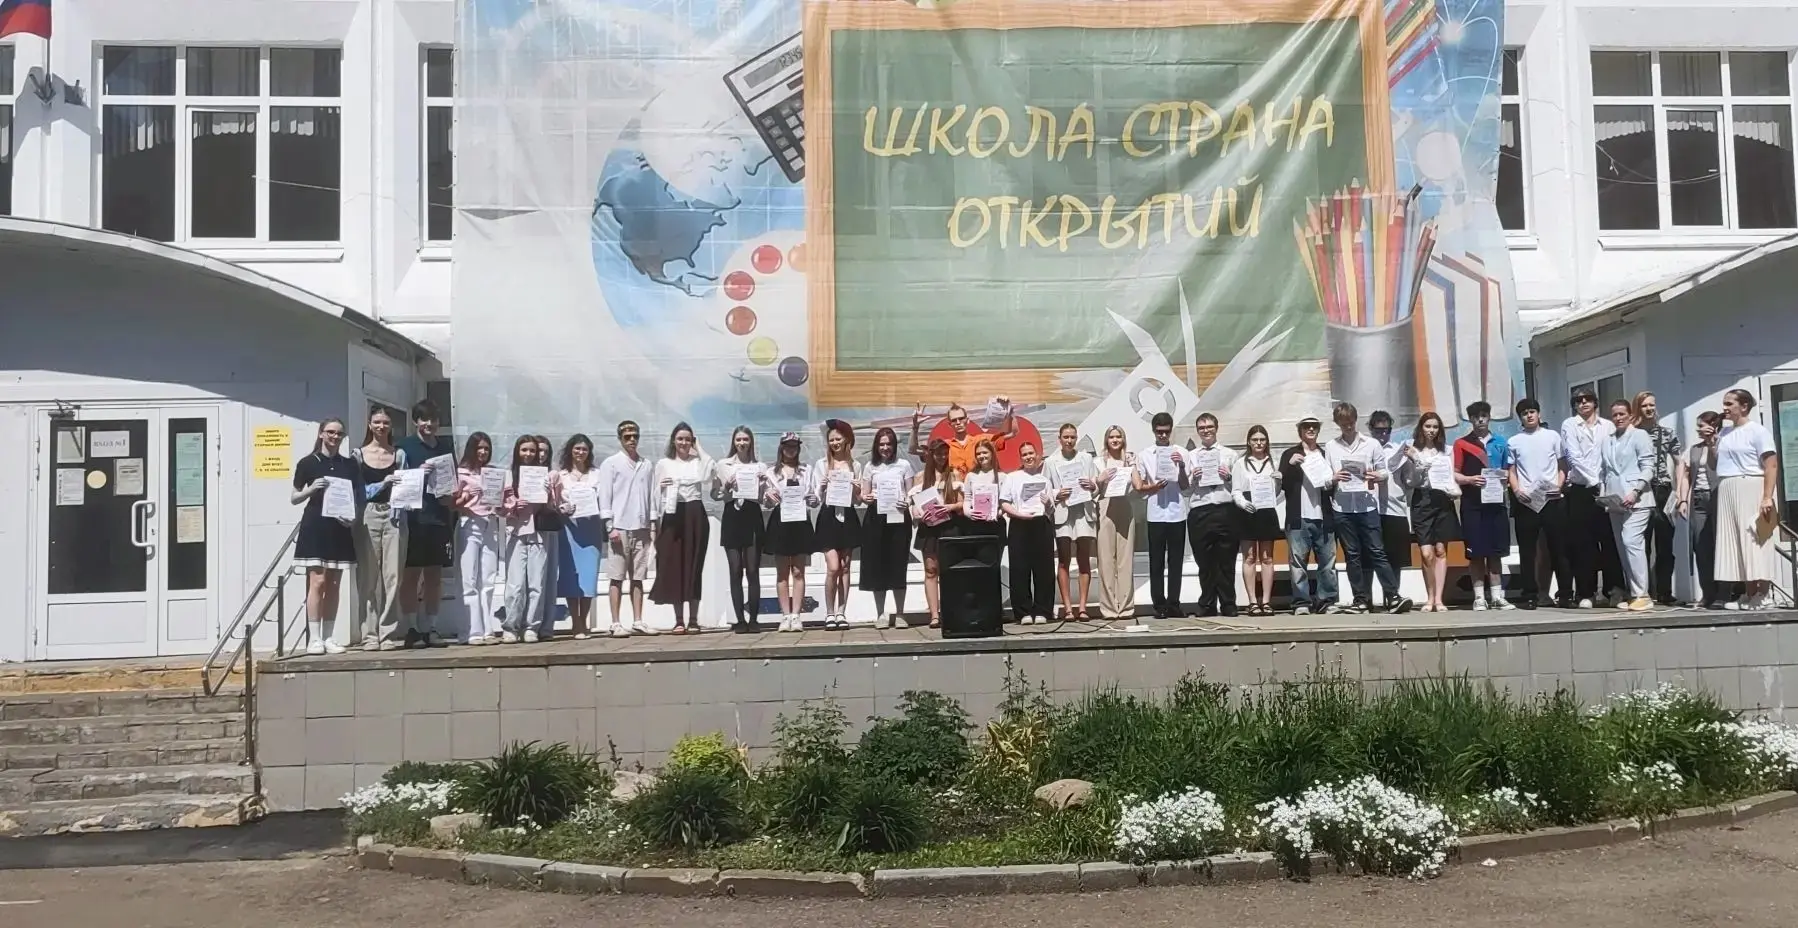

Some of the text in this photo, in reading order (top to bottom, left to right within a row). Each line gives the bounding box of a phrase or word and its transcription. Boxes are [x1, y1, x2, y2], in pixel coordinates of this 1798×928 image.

[864, 93, 1335, 162] ШКОЛА СТРАНА
[948, 174, 1264, 253] ОТКРЫТИЙ
